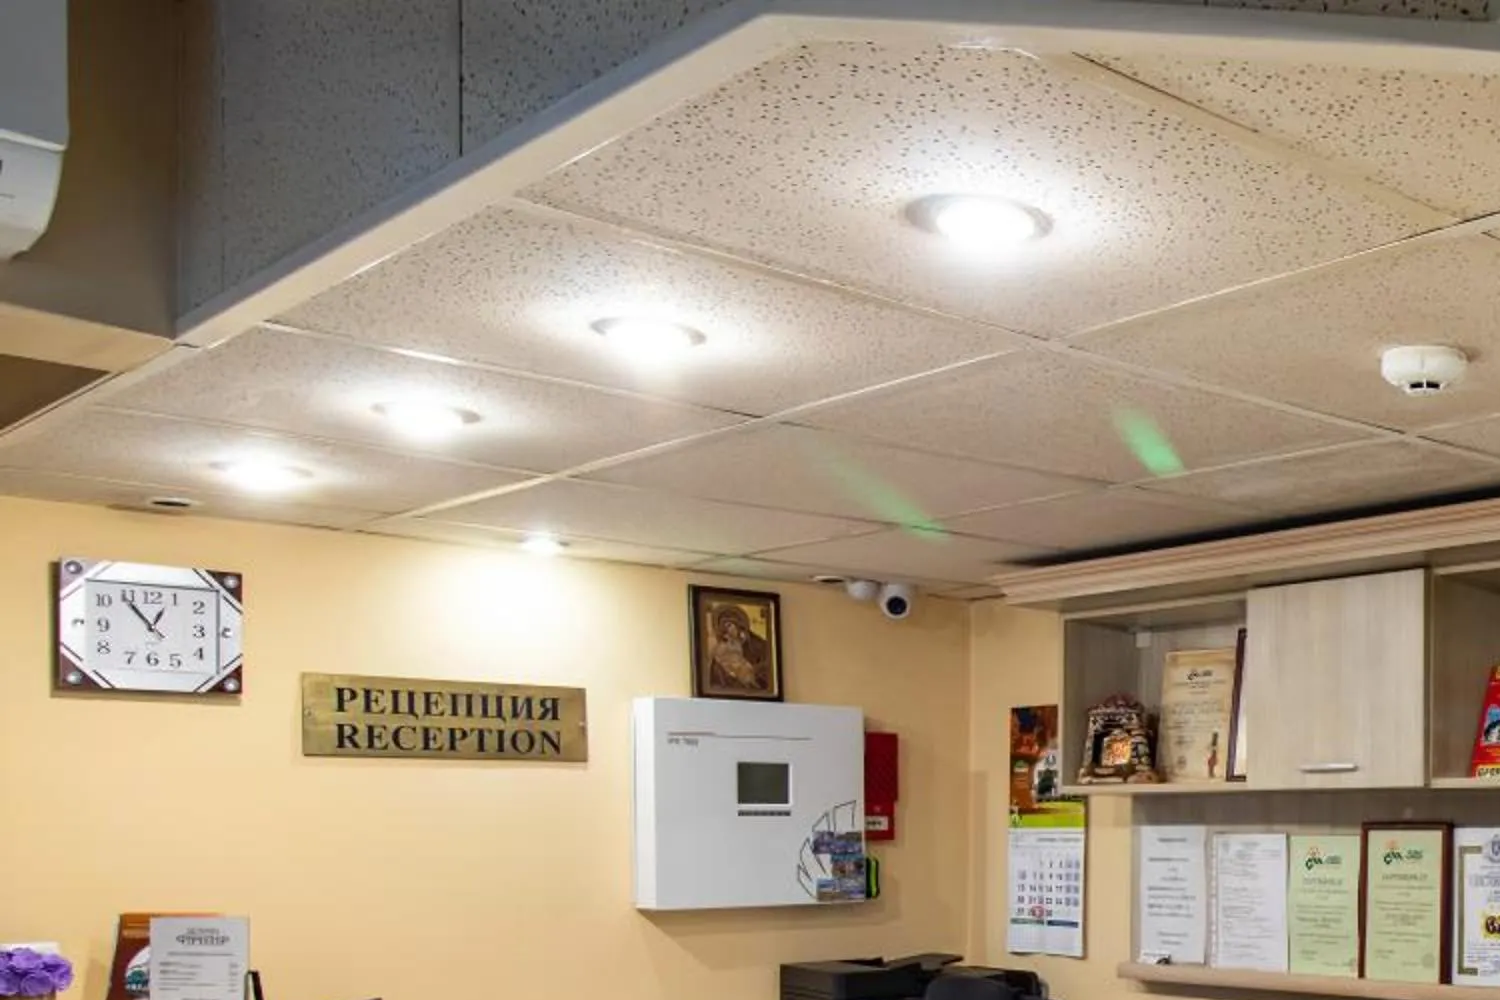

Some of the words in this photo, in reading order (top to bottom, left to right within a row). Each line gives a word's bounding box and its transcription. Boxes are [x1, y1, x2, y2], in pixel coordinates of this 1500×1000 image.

[96, 593, 112, 607] 10
[143, 591, 163, 605] 12
[192, 601, 206, 615] 2
[97, 619, 110, 632] 9
[192, 624, 206, 638] 3
[97, 640, 111, 654] 8
[193, 647, 204, 661] 4
[123, 651, 137, 665] 7
[145, 652, 159, 666] 6
[169, 653, 182, 668] 5
[335, 687, 561, 723] РЕЦЕПЦИЯ
[335, 723, 562, 755] RECEPTION
